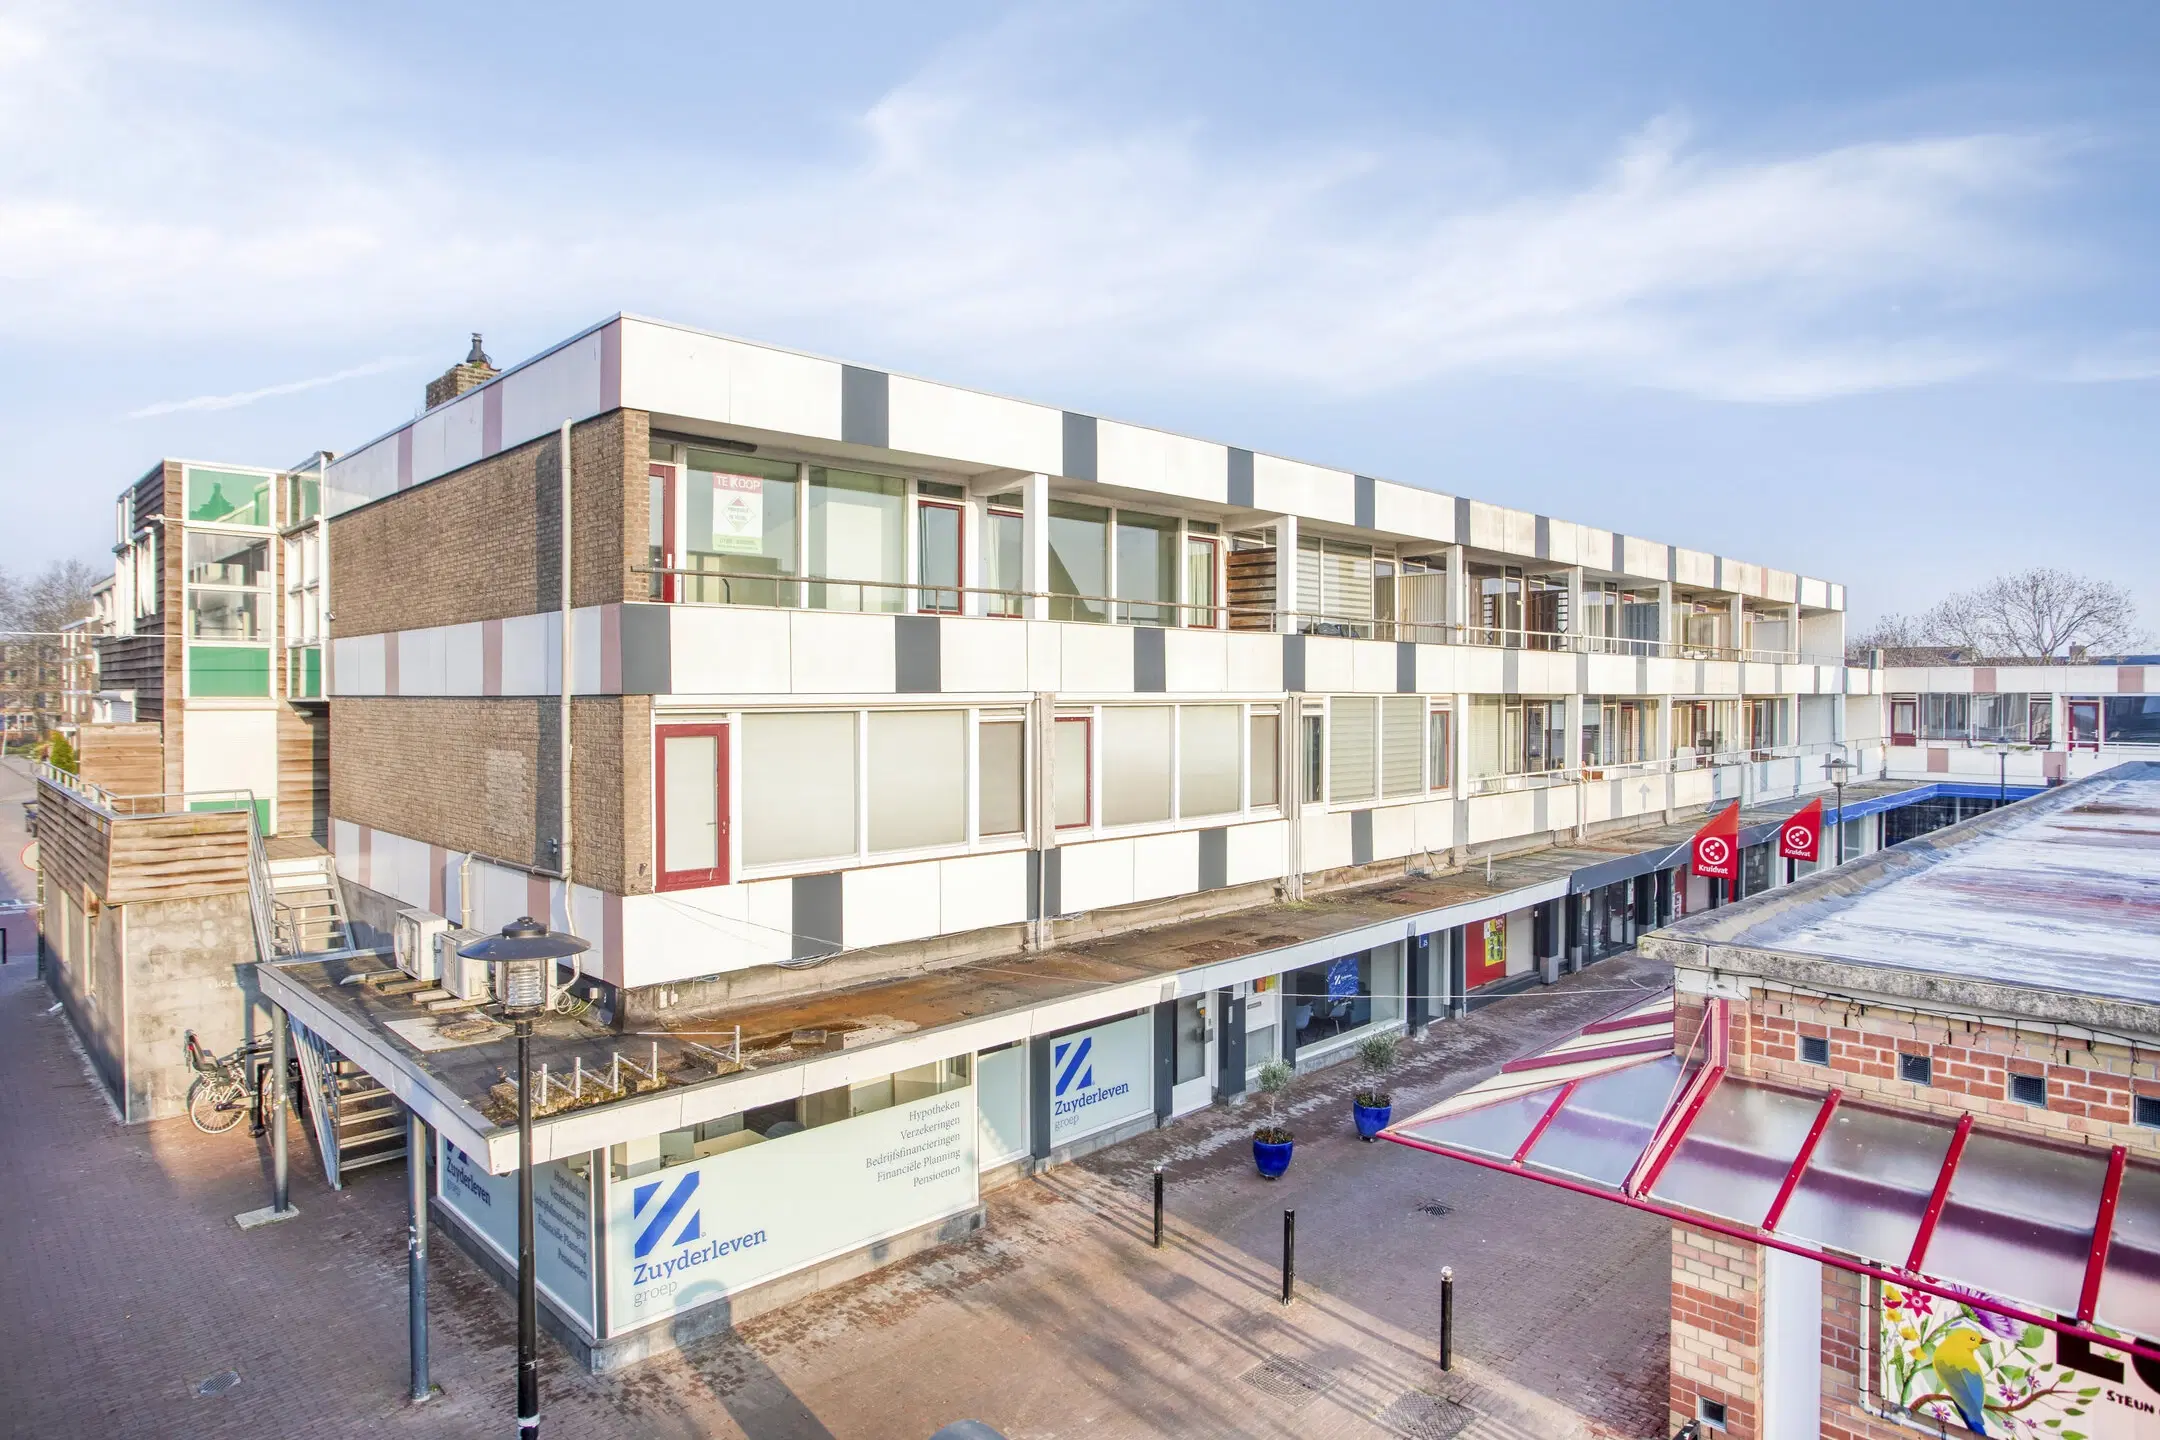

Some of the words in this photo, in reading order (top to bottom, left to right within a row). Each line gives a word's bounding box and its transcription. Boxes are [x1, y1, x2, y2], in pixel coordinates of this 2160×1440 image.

[716, 475, 728, 487] TE
[730, 478, 760, 490] KOOP
[1785, 848, 1811, 857] Kruidvat
[1698, 864, 1729, 875] Kruidvat
[909, 1100, 960, 1122] Hypotheken
[1055, 1082, 1129, 1116] Zuyderleven
[900, 1116, 960, 1140] Verzekeringen
[1054, 1114, 1079, 1132] groep
[865, 1132, 960, 1168] Bedrijfsfinancieringen
[877, 1159, 922, 1182] Financiële
[923, 1149, 961, 1168] Planning
[913, 1165, 961, 1187] Pensioenen
[446, 1156, 491, 1207] Zuyderleven
[633, 1229, 768, 1286] Zuyderleven
[633, 1281, 678, 1308] groep
[2106, 1389, 2155, 1414] STEUN
